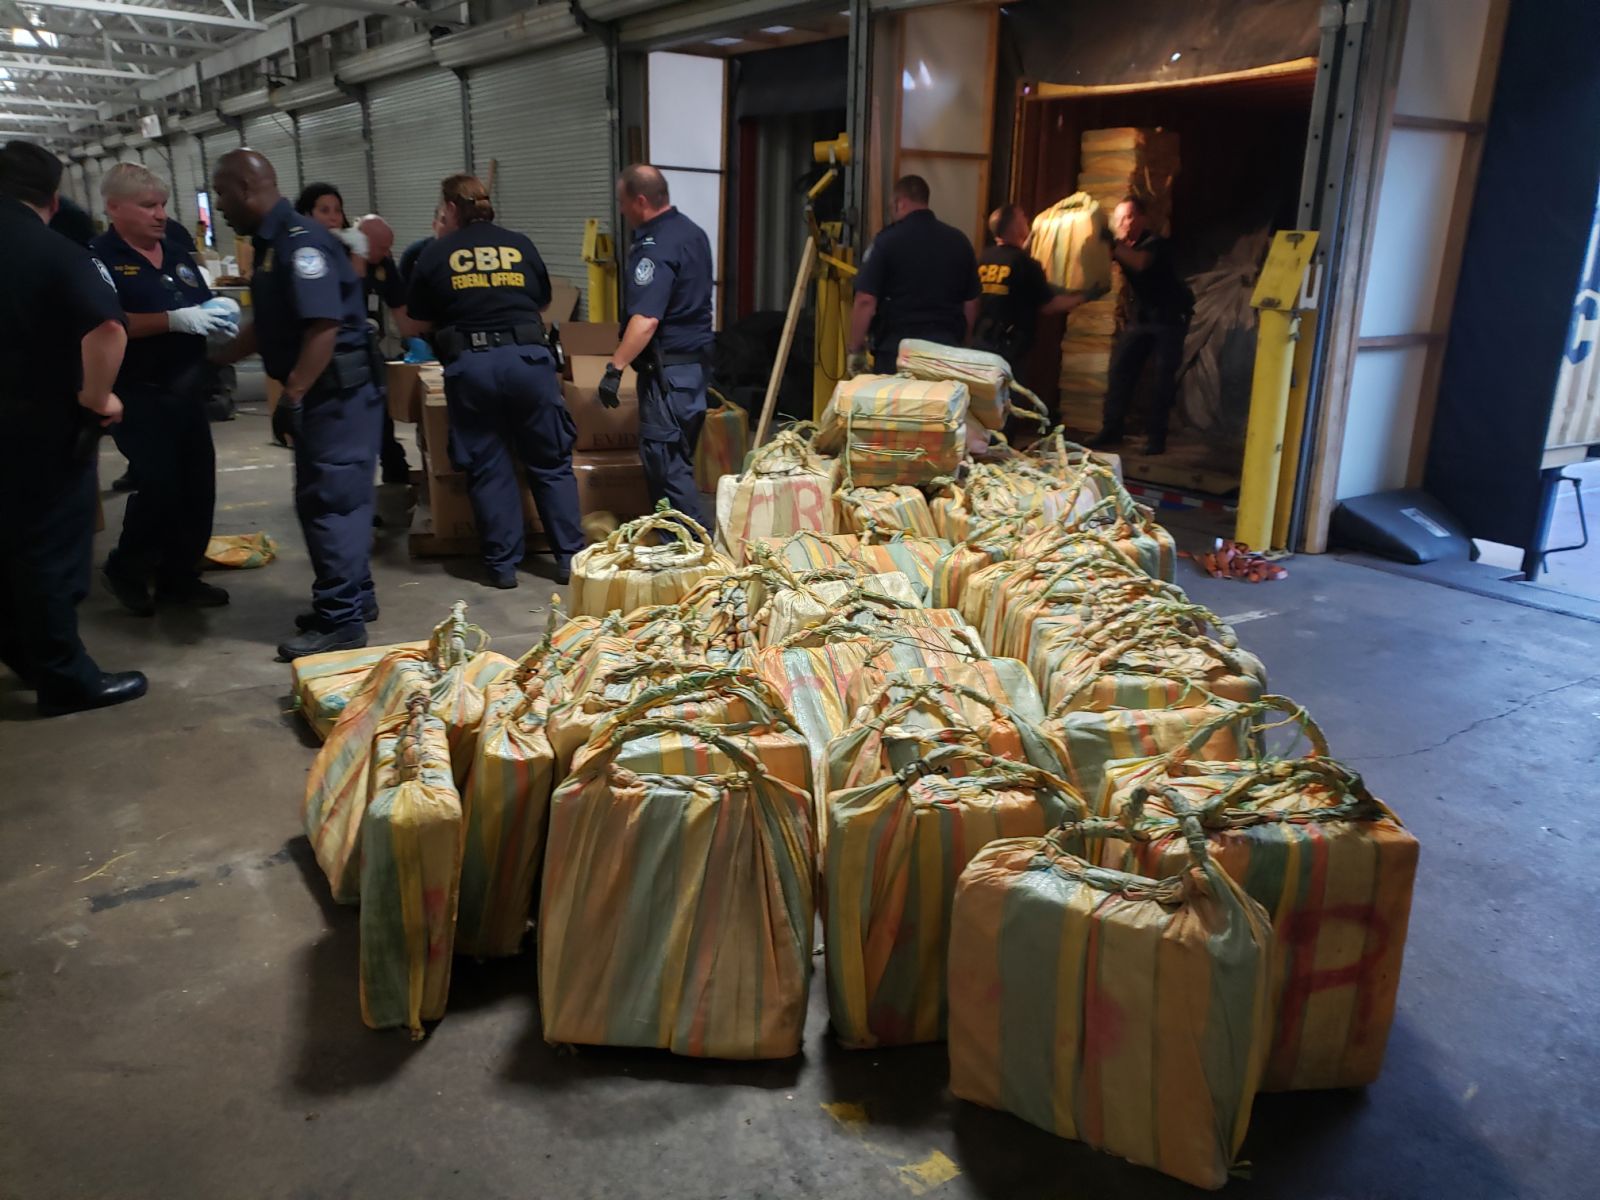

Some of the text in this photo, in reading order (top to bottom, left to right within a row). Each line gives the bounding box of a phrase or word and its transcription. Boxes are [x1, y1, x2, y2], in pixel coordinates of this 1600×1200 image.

[449, 246, 523, 273] CBP
[451, 272, 525, 289] FEDERAL OFFICER
[978, 264, 1011, 284] CBP
